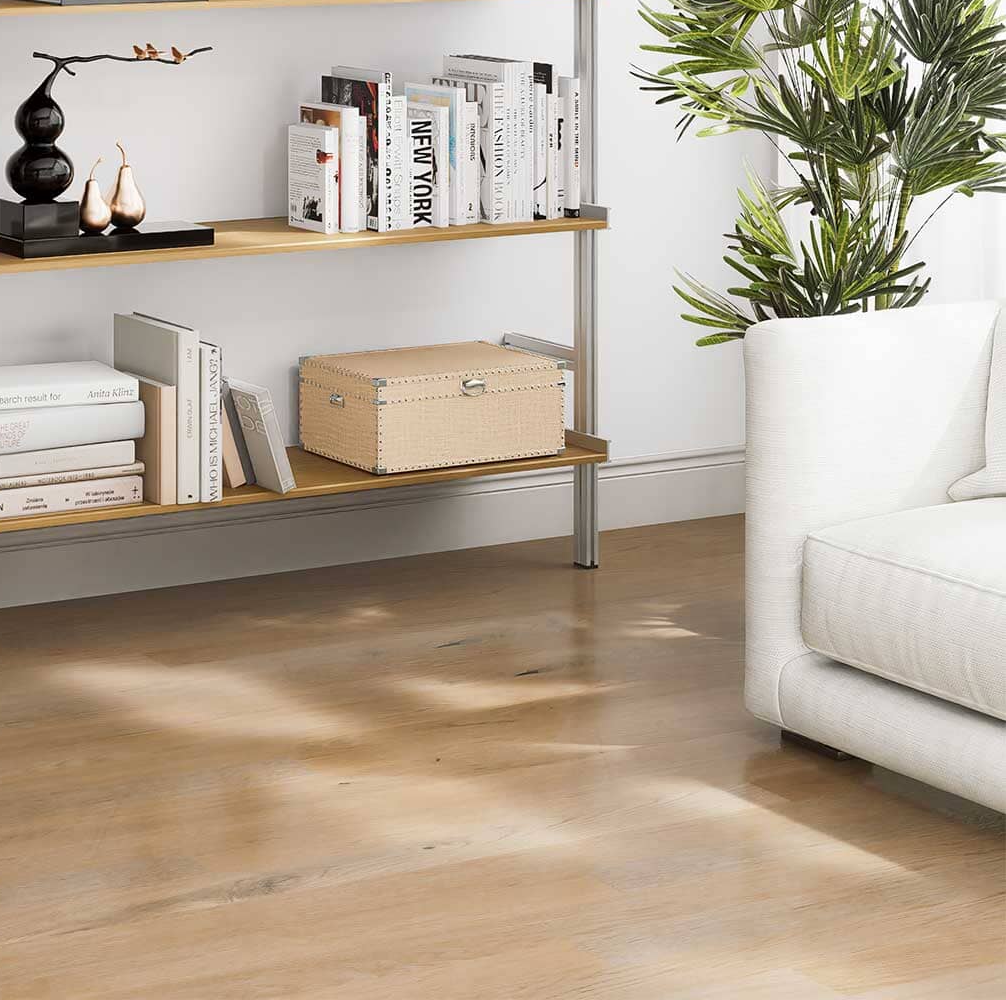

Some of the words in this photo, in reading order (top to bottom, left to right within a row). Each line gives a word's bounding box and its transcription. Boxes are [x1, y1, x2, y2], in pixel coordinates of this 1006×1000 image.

[494, 86, 504, 114] THE
[410, 121, 432, 165] NEW
[494, 117, 504, 178] FASHION
[414, 170, 432, 225] YORK
[494, 181, 504, 221] BOOK
[24, 394, 48, 404] result
[50, 392, 62, 402] for
[88, 390, 111, 400] Anita
[112, 388, 134, 399] Klinz
[209, 358, 218, 398] JANG?
[10, 421, 30, 430] GREAT
[209, 400, 218, 454] MICHAEL
[209, 456, 218, 467] IS
[209, 469, 218, 502] WHO
